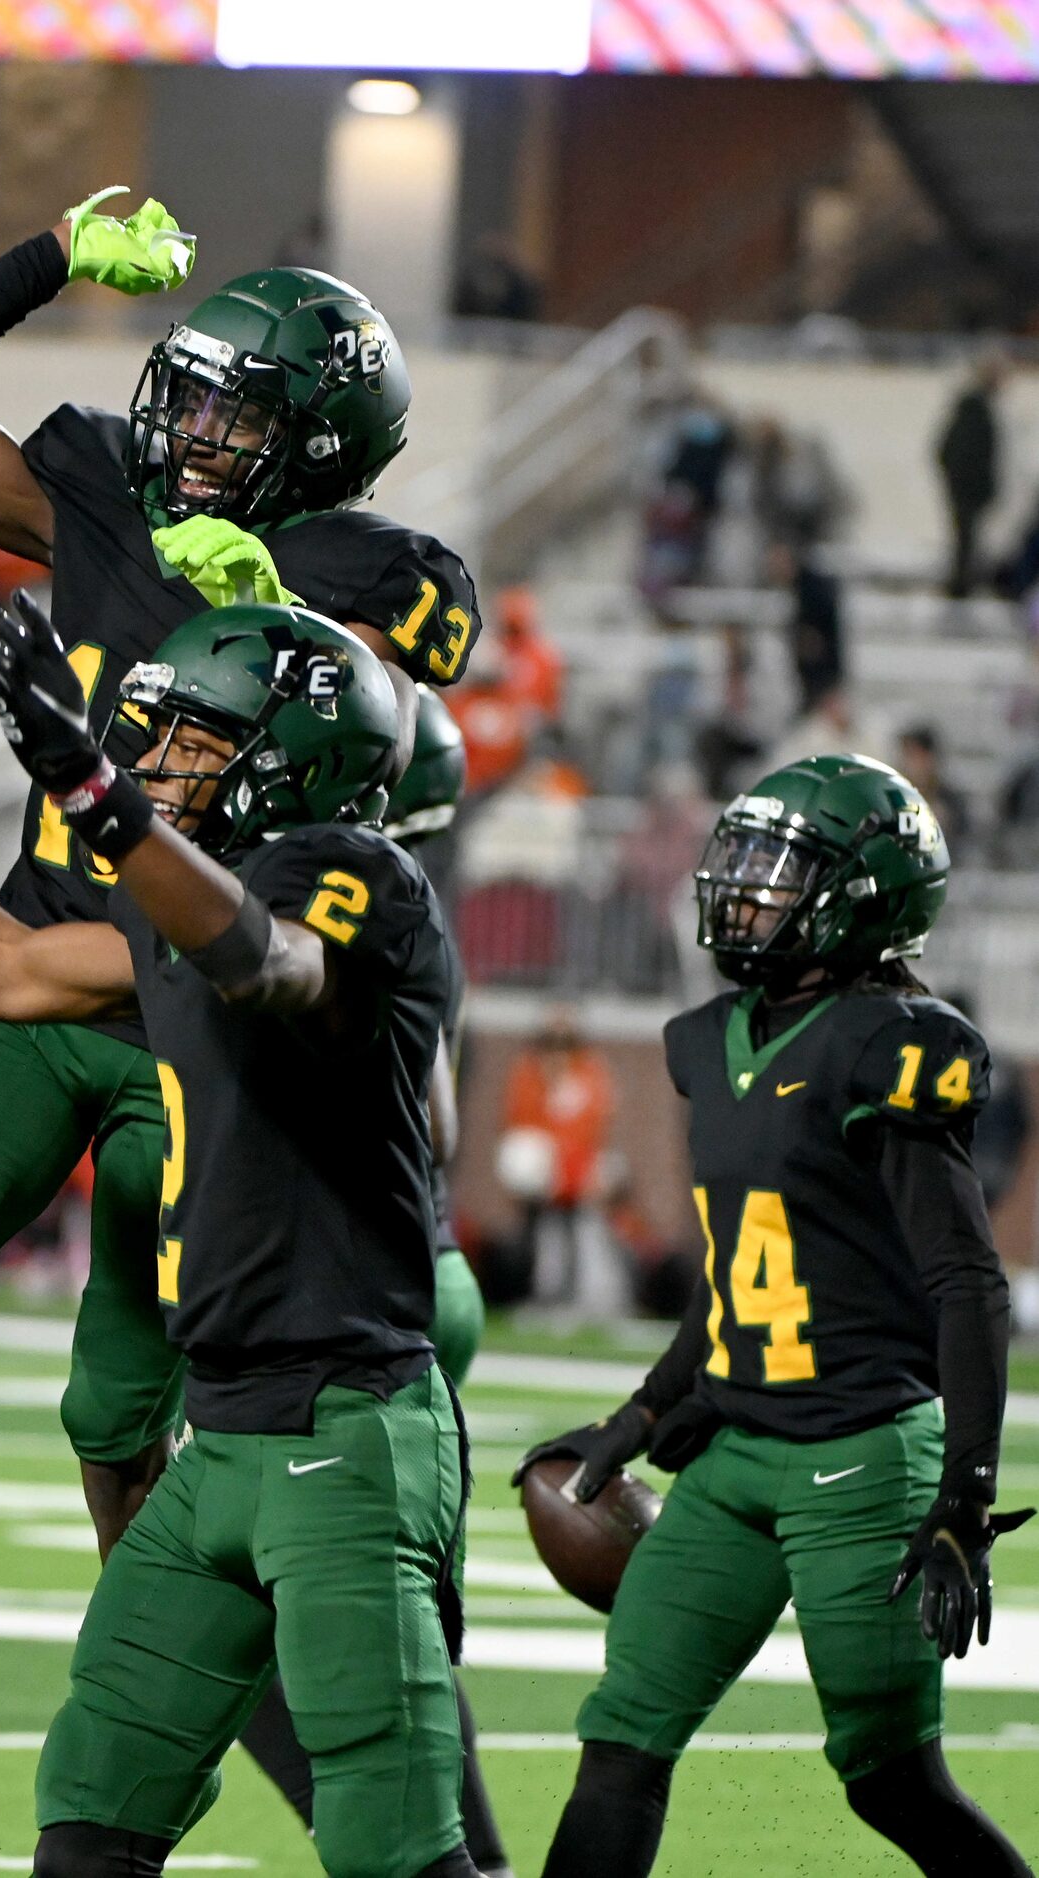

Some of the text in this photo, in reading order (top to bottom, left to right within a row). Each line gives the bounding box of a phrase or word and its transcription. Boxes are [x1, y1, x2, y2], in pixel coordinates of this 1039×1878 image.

[387, 579, 471, 680] 13
[303, 869, 370, 945] 2
[886, 1043, 972, 1112] 14
